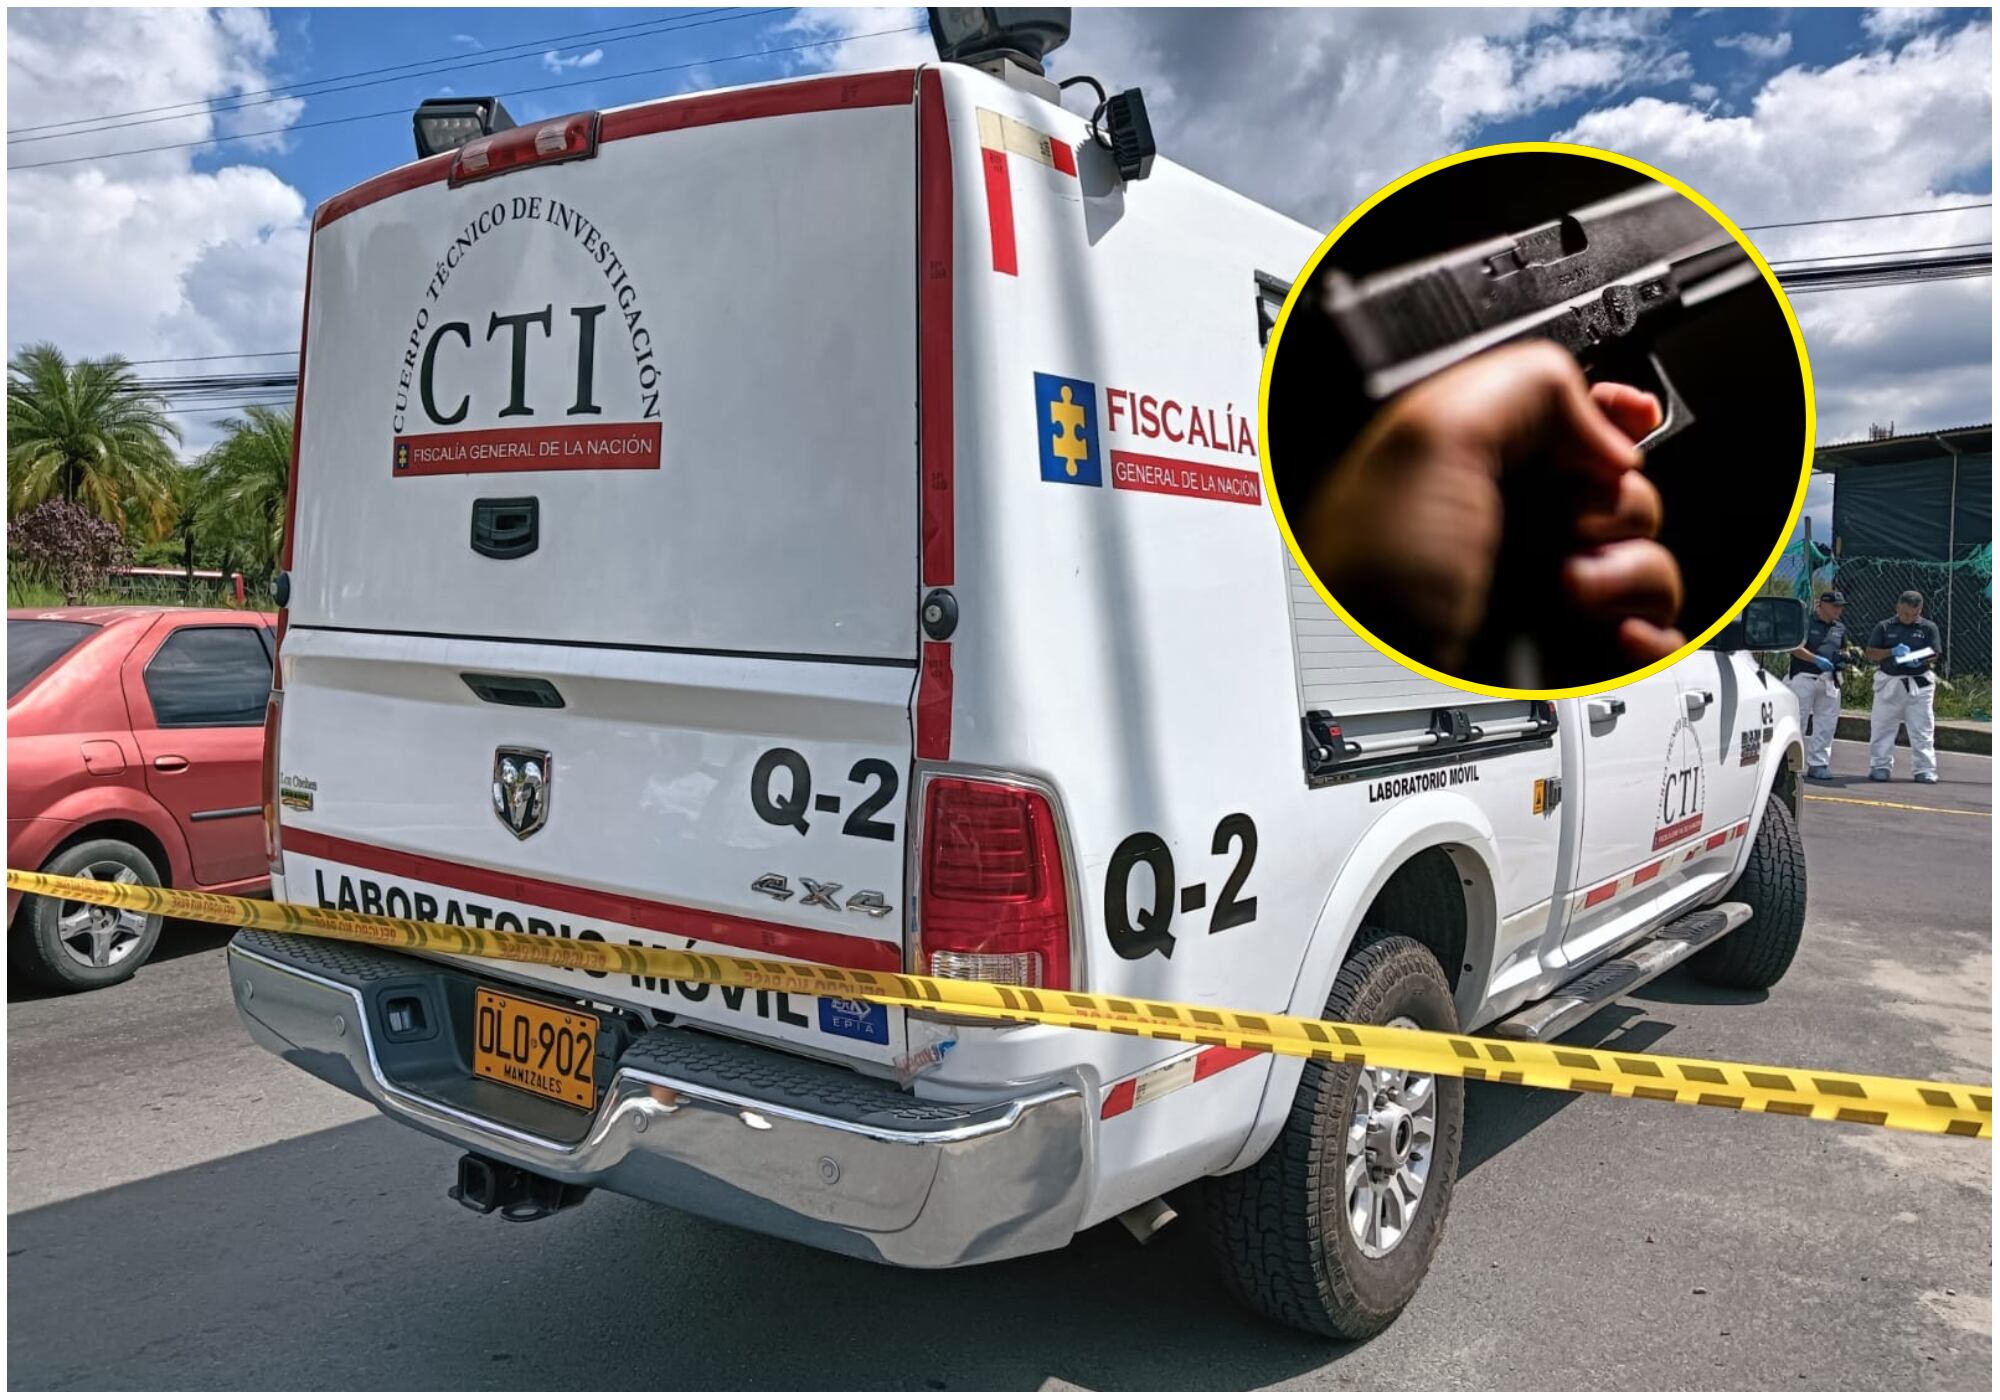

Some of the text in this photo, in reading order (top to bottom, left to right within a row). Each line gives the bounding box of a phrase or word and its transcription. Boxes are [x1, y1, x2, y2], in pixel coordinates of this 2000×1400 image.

[392, 196, 662, 434] CUERPO TÉCNICO DE INVESTIGACIÓN
[419, 303, 607, 425] CTI
[413, 433, 653, 462] FISCALÍA GENERAL DE LA NACIÓN
[1105, 387, 1258, 457] FISCALÍA
[1115, 461, 1259, 498] GENERAL DE LA NACIÓN
[750, 747, 900, 841] Q-2
[1368, 769, 1448, 803] LABORATORIO
[1663, 766, 1700, 825] CTI
[1102, 811, 1259, 961] Q-2
[504, 1063, 563, 1094] MANIZALES
